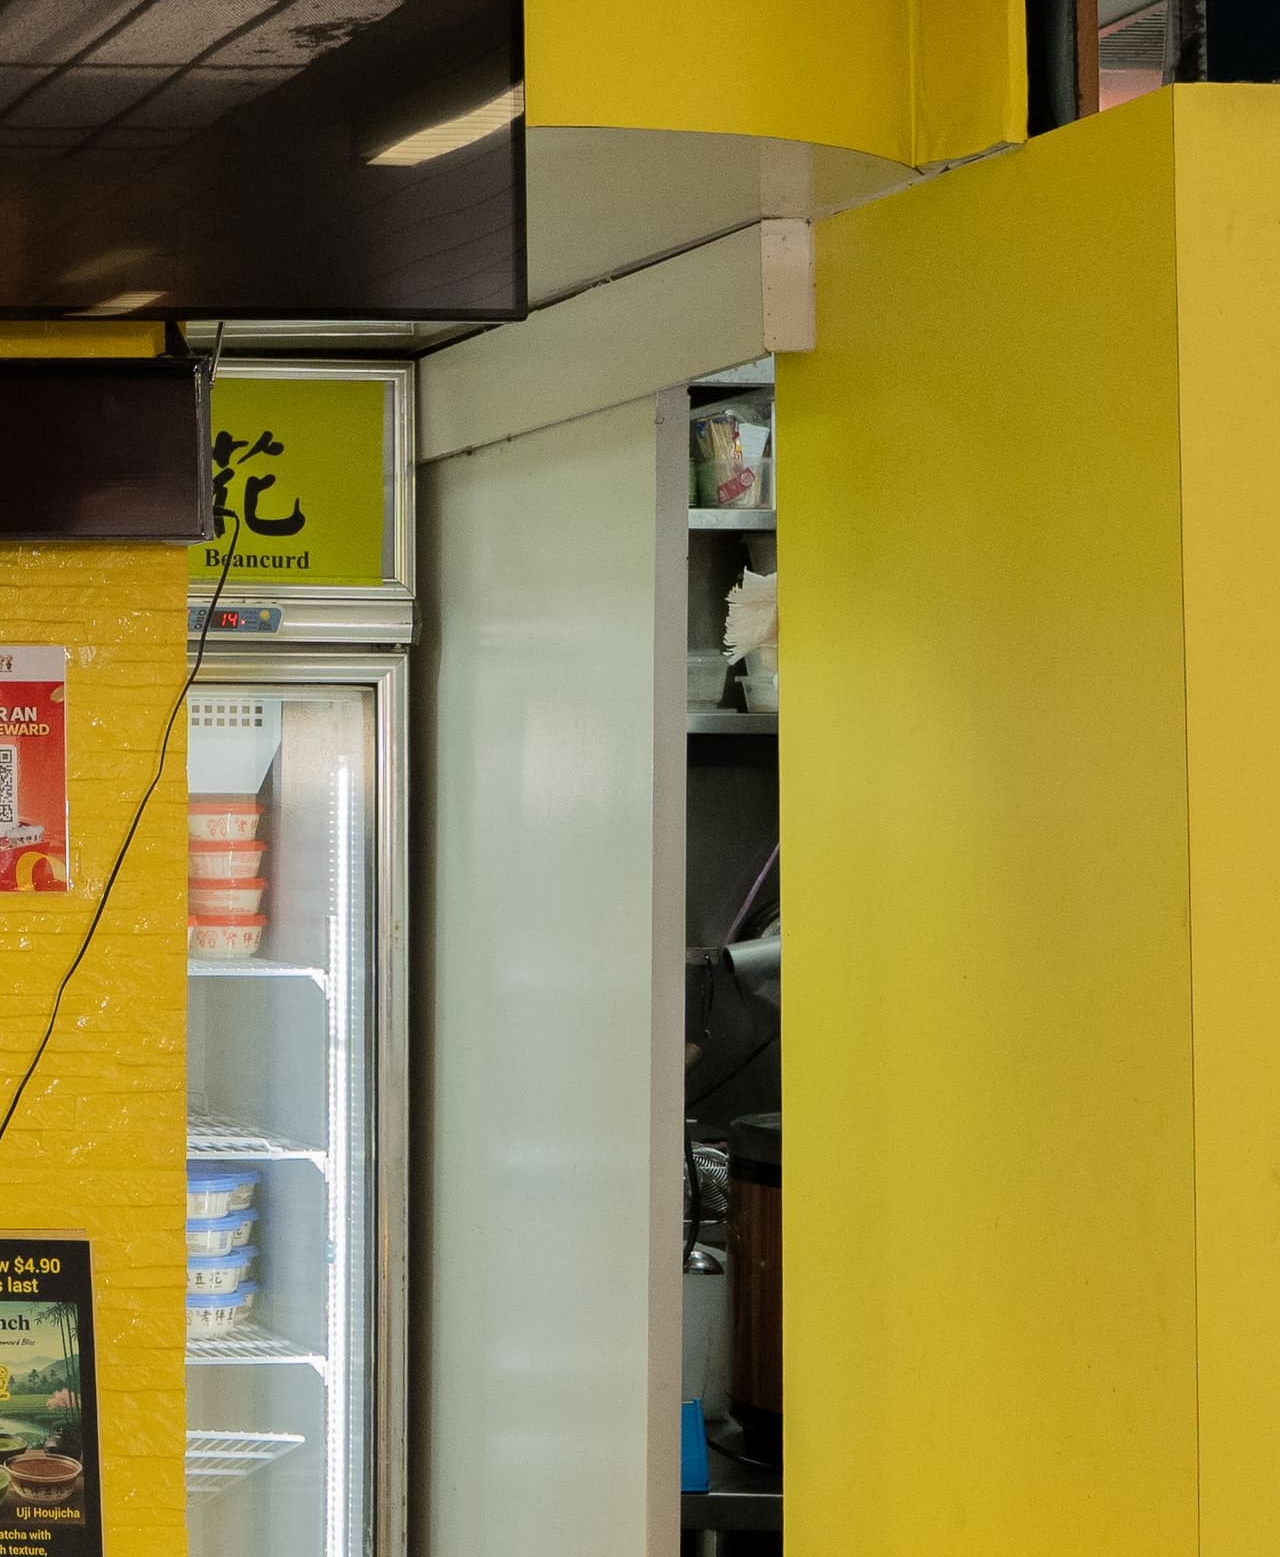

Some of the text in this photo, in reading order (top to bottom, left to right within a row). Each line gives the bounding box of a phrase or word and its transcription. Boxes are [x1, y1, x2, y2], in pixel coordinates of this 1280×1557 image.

[205, 549, 310, 569] Beancurd
[12, 707, 37, 721] AN
[14, 1256, 61, 1274] $4.90
[8, 1277, 39, 1292] last
[16, 1508, 80, 1520] Uji Houjicha
[29, 1530, 51, 1540] with
[9, 1546, 48, 1557] texture,
